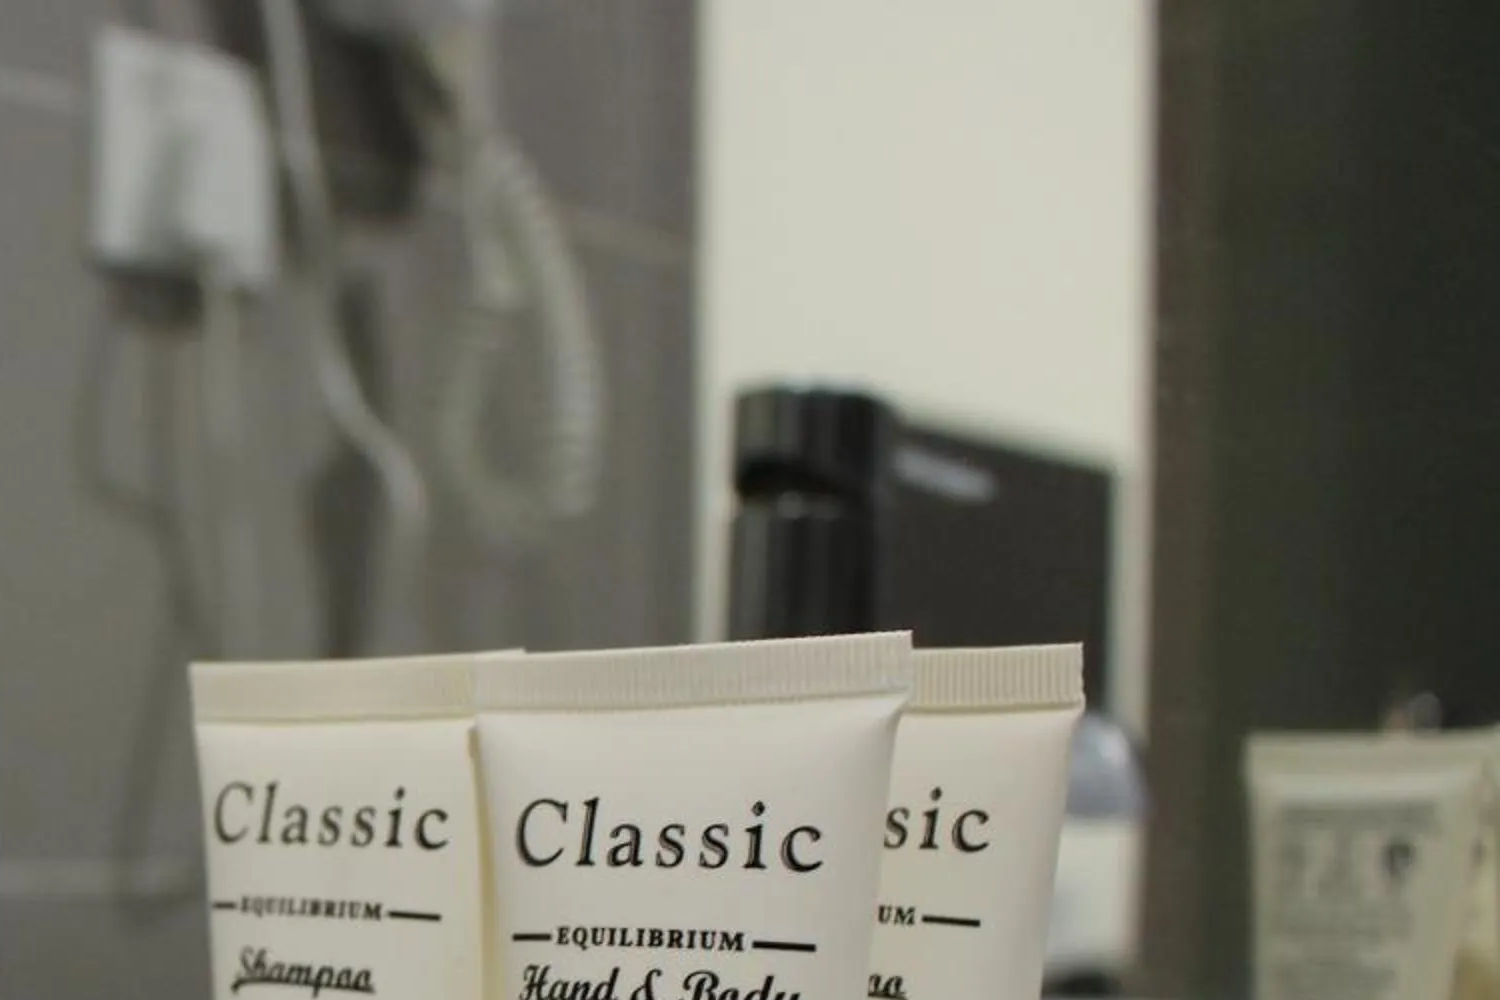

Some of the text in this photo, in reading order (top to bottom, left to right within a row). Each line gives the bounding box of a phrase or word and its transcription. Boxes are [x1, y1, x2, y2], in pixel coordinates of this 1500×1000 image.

[214, 780, 450, 851] Classic
[515, 796, 824, 873] Classic
[241, 895, 382, 921] EQUILIBRIUM
[556, 926, 745, 951] EQUILIBRIUM
[231, 946, 375, 999] Shampoo
